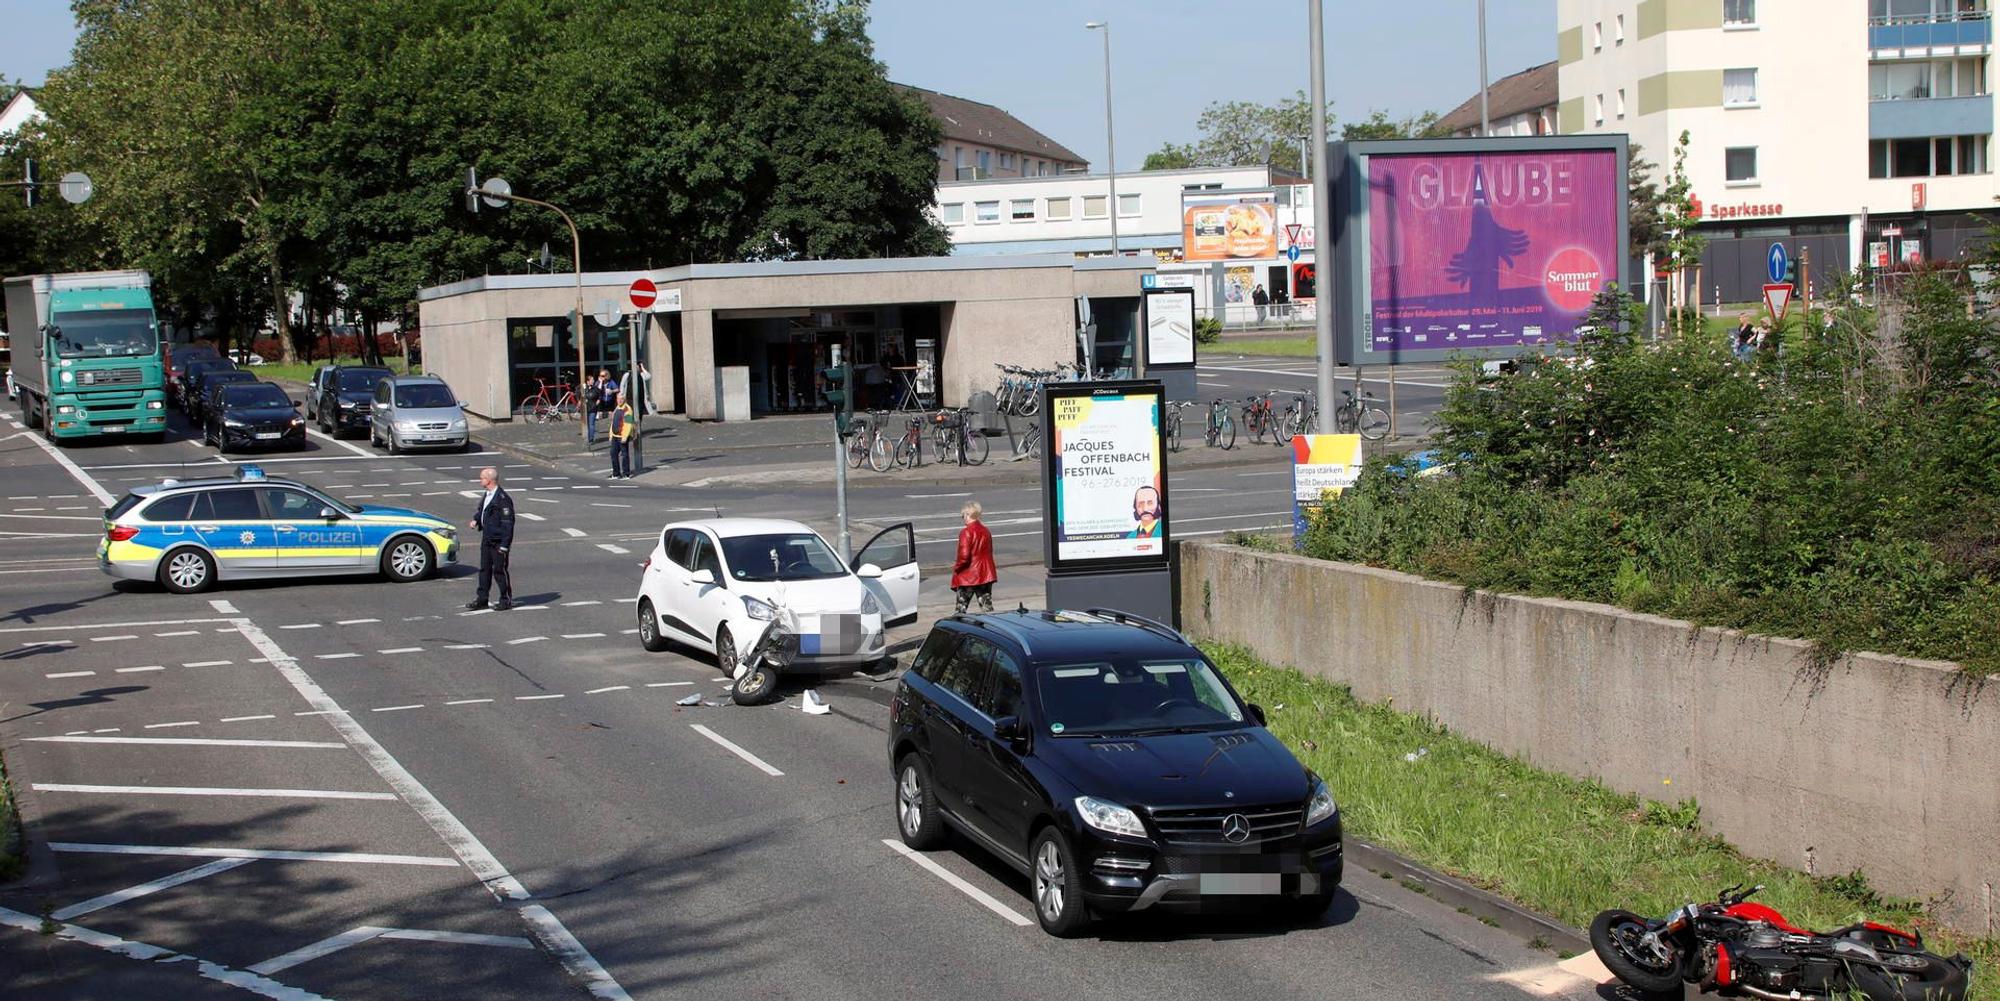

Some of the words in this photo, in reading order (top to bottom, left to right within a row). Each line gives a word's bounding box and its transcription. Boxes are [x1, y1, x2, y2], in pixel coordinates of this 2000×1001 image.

[1409, 160, 1573, 208] GLAUBE
[1710, 202, 1783, 220] Sparkasse
[1145, 275, 1154, 286] U
[1548, 270, 1599, 283] Sommer
[1564, 280, 1591, 292] blut
[1063, 439, 1114, 453] JACQUES
[1080, 452, 1150, 464] OFFENBACH
[1064, 467, 1115, 477] FESTIVAL
[1296, 466, 1316, 475] Europa
[1316, 465, 1343, 475] stärken
[299, 531, 356, 543] POLIZEI
